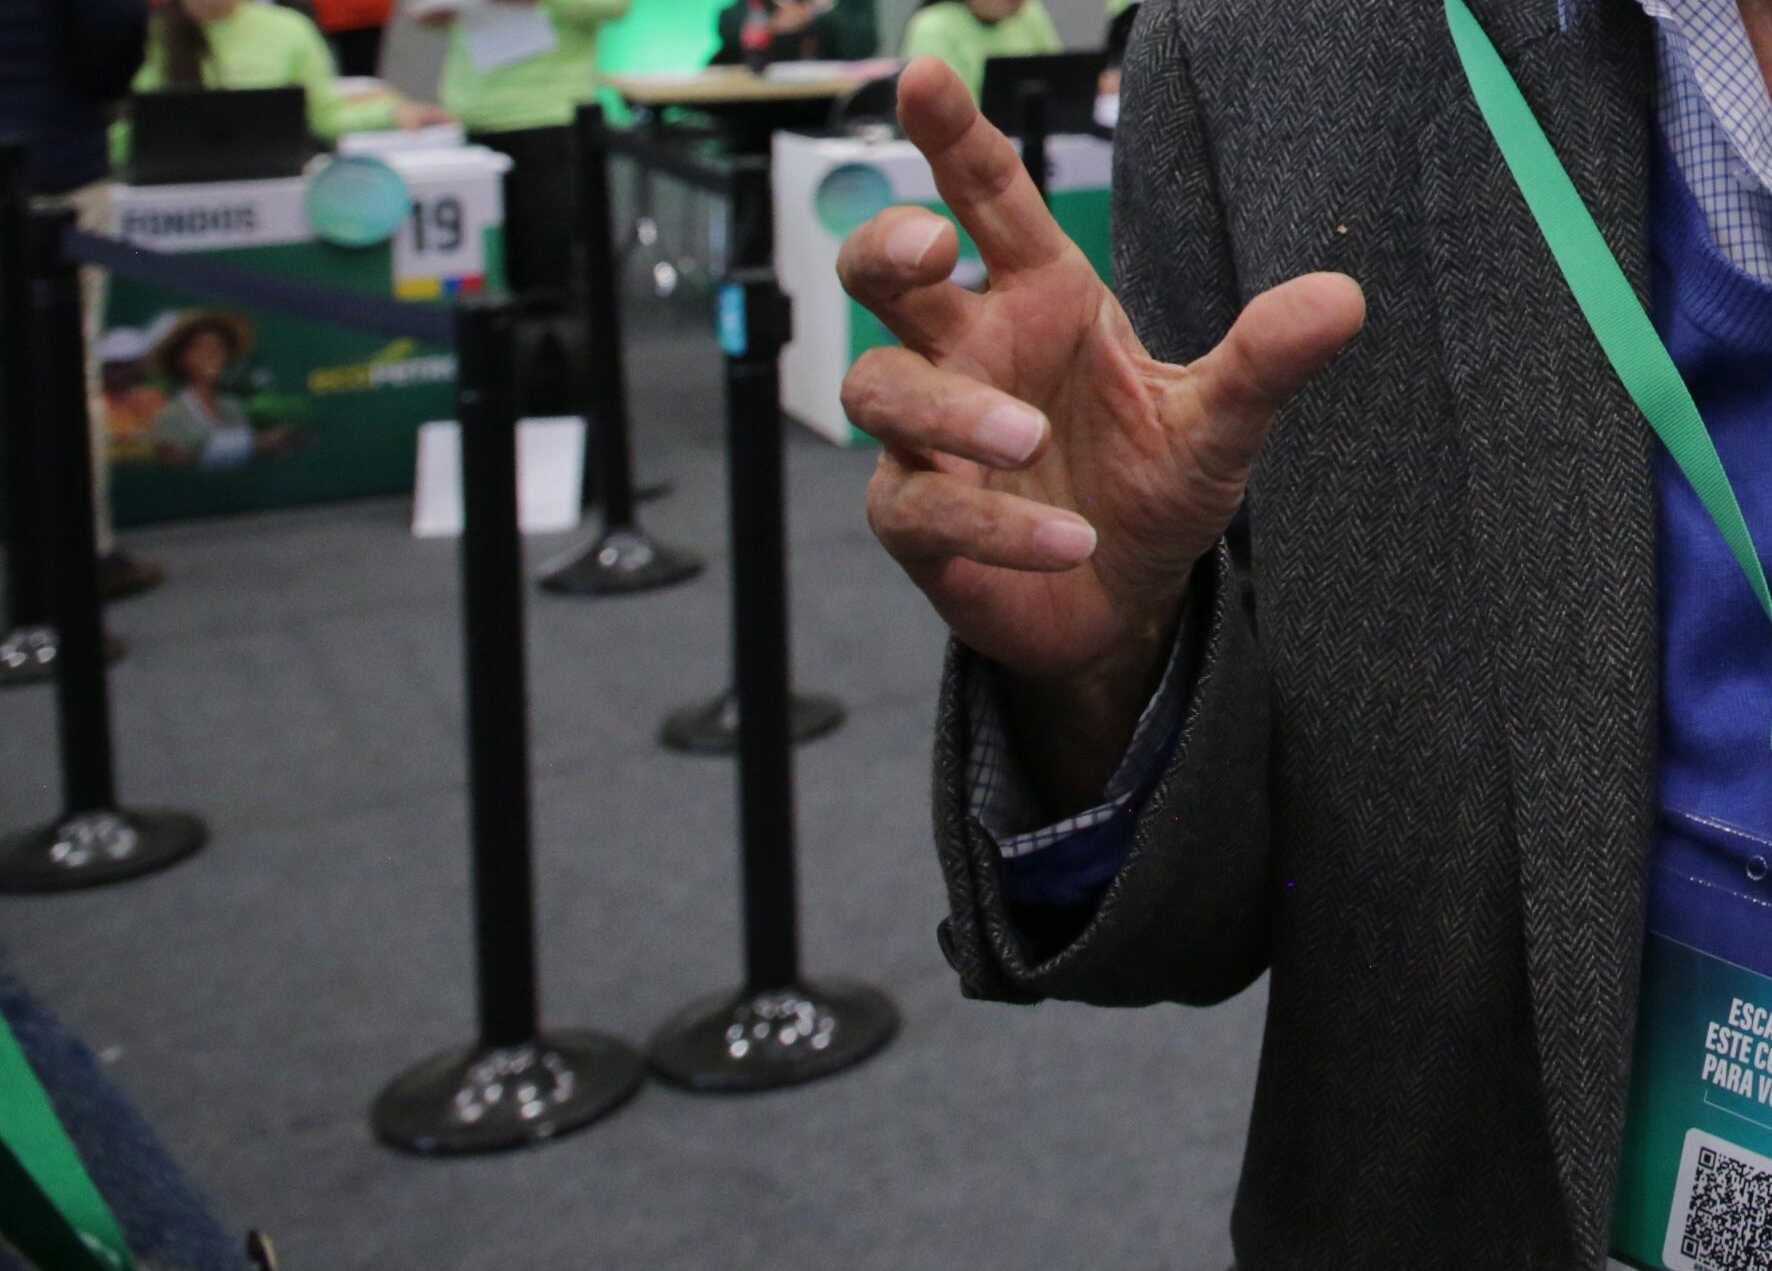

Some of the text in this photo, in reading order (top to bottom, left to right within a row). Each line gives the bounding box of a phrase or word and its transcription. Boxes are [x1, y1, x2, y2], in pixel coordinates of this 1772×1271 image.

[411, 196, 465, 252] 19
[1705, 1021, 1753, 1064] ESTE
[1702, 1053, 1753, 1099] PARA
